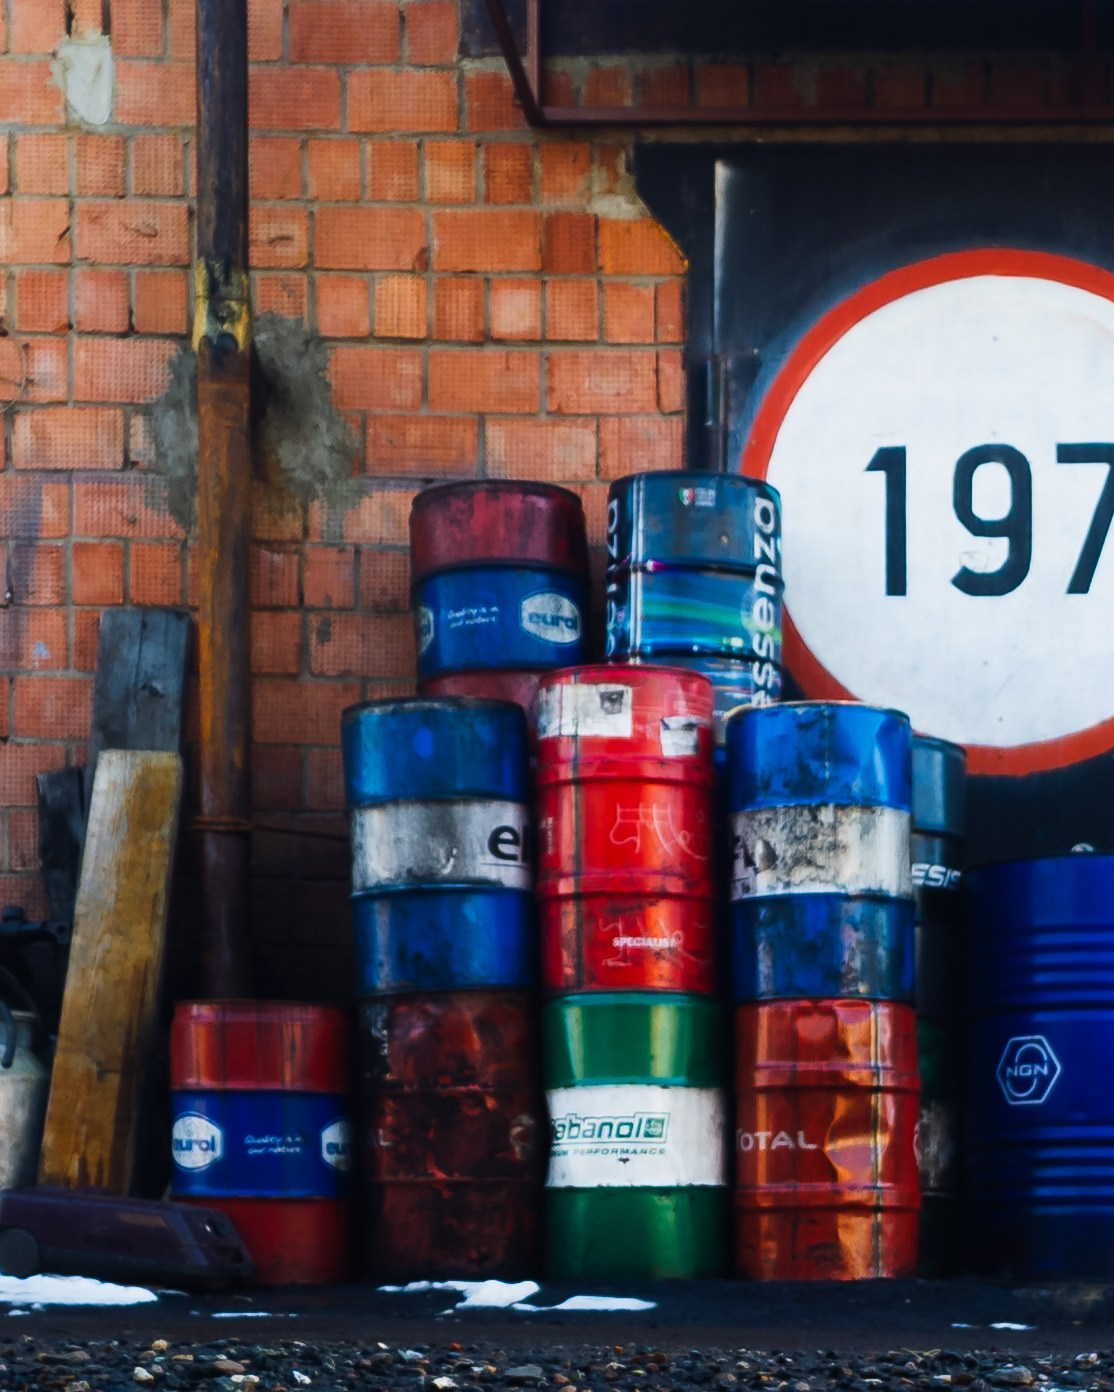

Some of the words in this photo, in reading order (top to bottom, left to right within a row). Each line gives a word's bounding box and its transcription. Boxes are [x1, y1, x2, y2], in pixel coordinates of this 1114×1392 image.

[1006, 1062, 1048, 1077] NGN
[551, 1117, 643, 1141] abanol
[738, 1129, 818, 1151] OTAL
[573, 1147, 666, 1157] PERFORMANCE
